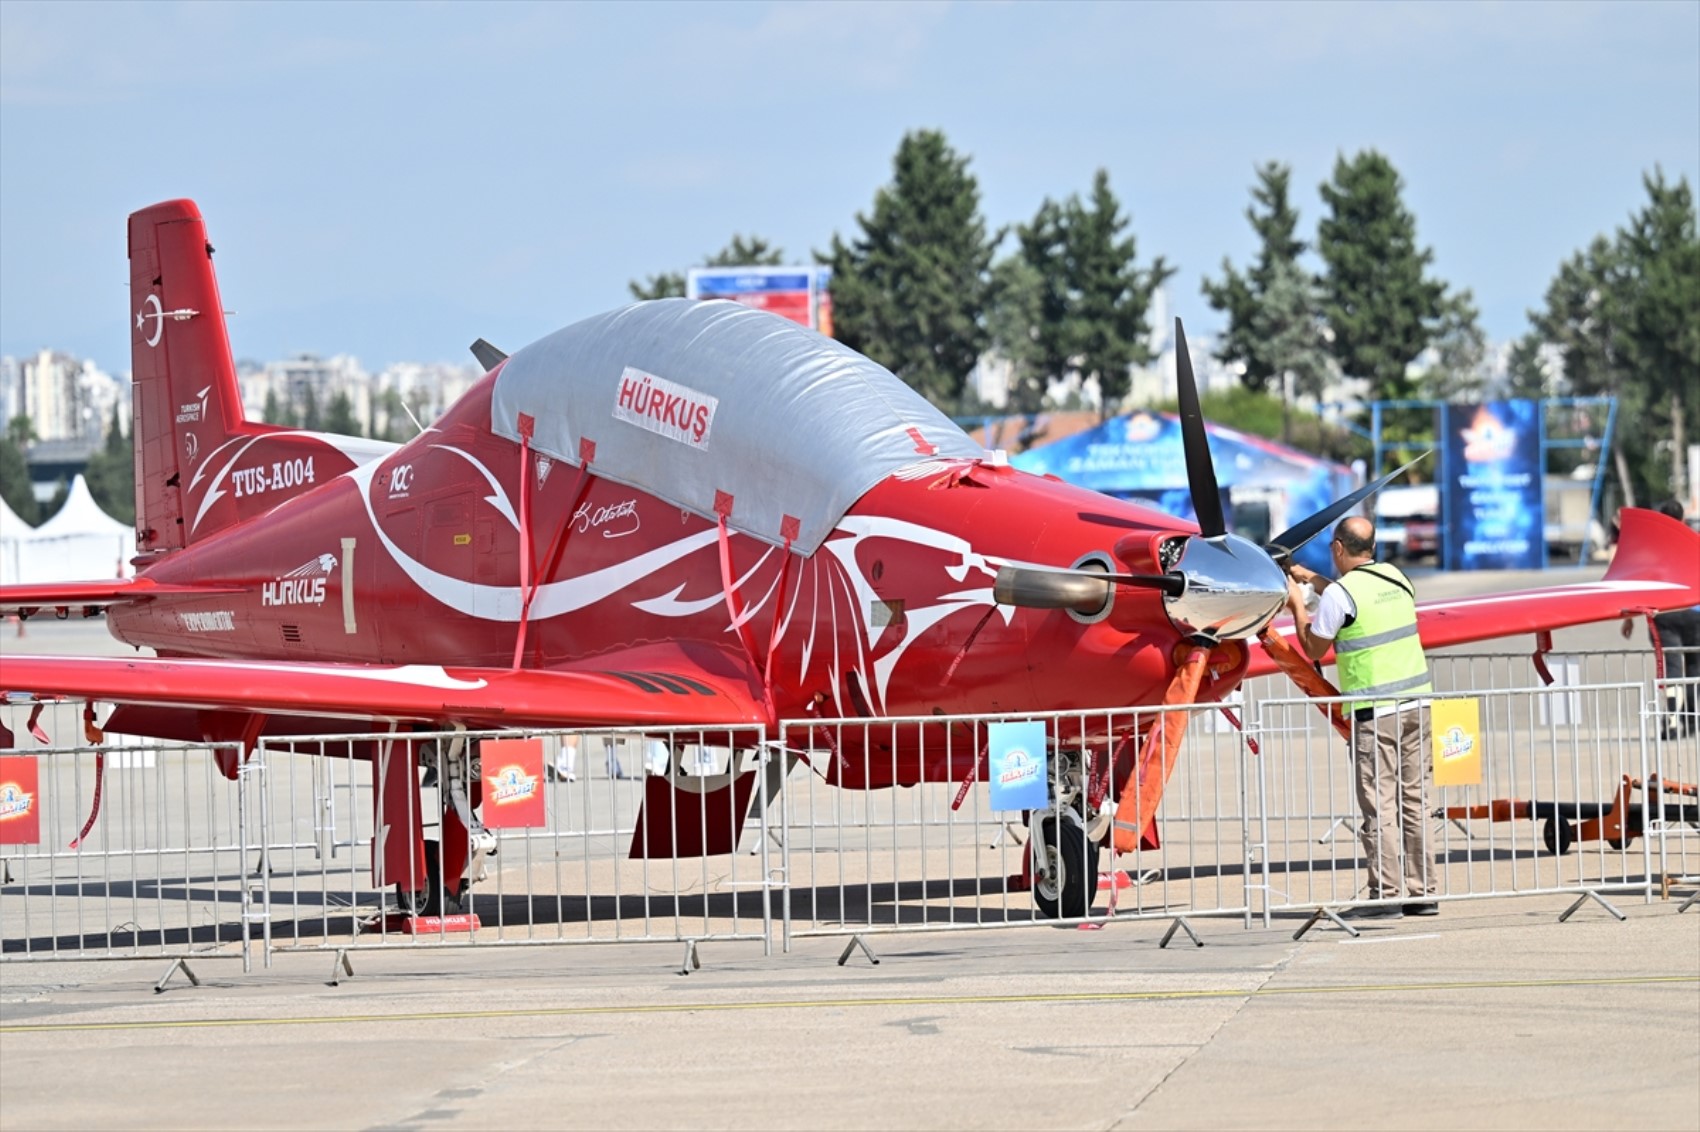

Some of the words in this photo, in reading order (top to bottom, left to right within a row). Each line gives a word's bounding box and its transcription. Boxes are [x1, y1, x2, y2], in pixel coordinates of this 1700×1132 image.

[618, 377, 709, 443] HÜRKUŞ
[232, 456, 315, 497] TUS-A004
[262, 577, 327, 607] HÜRKUŞ
